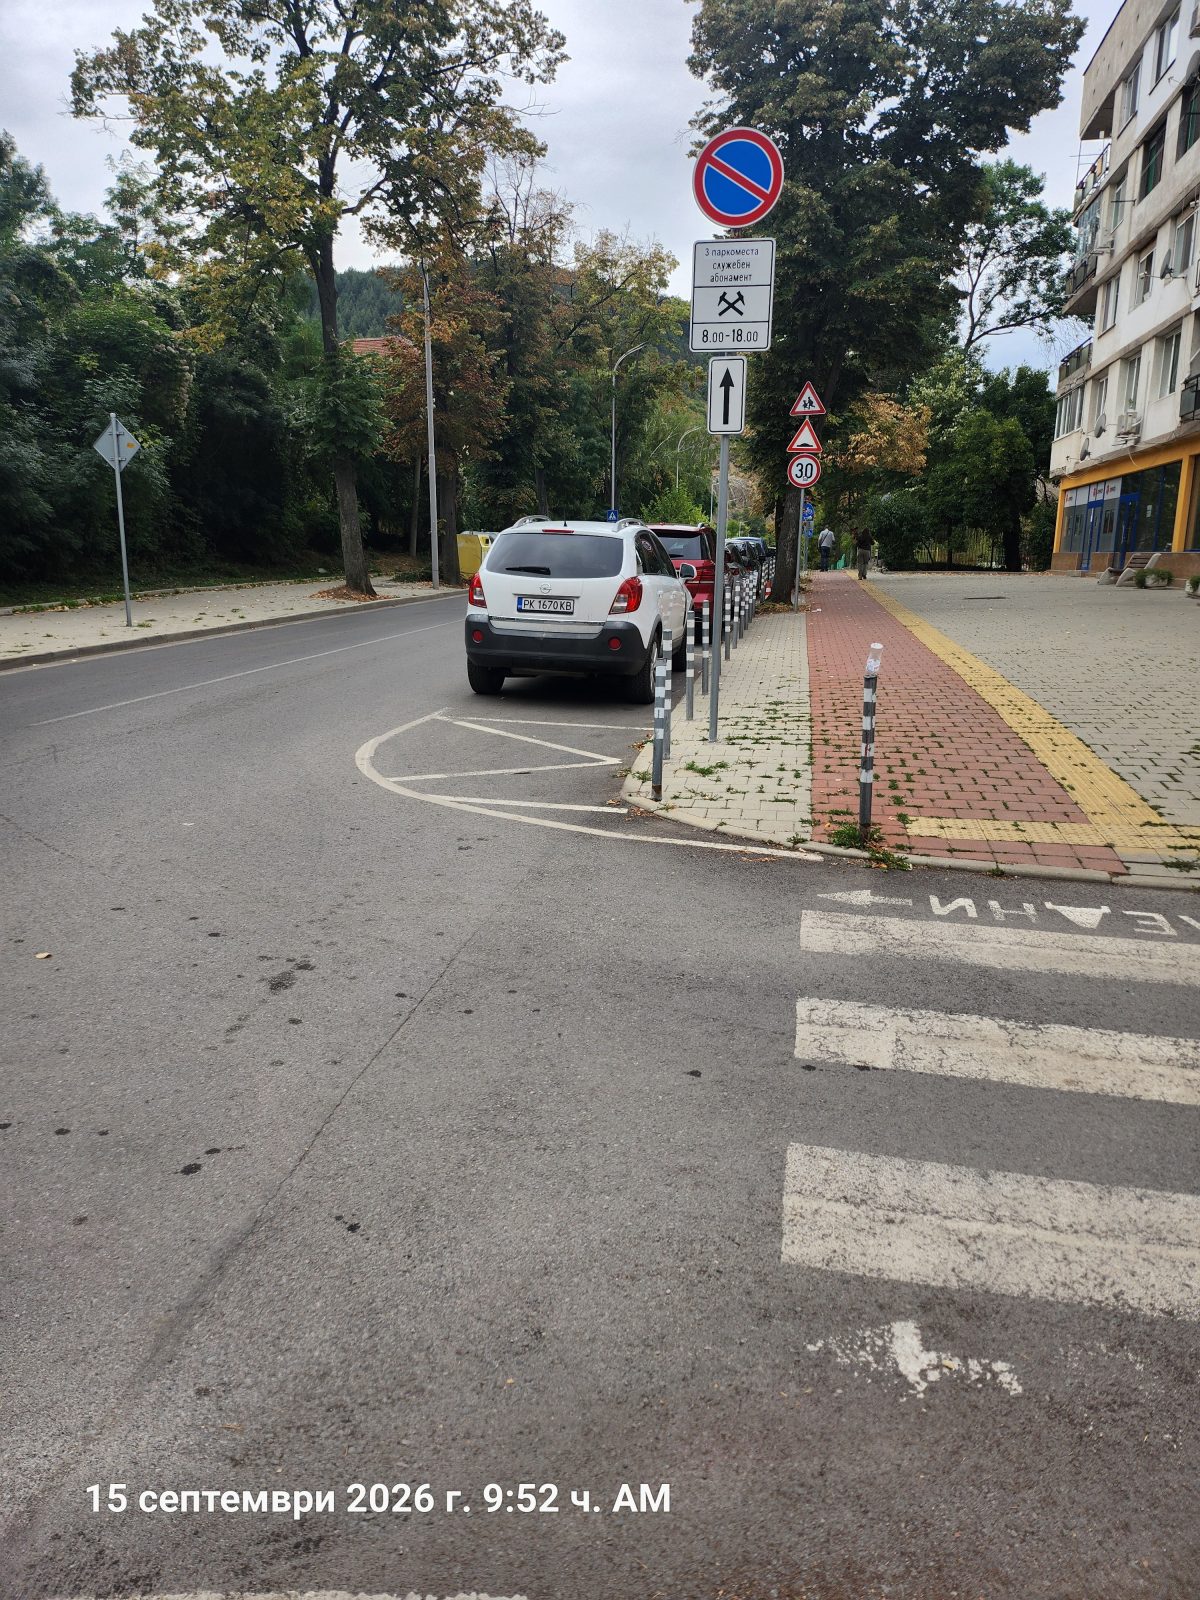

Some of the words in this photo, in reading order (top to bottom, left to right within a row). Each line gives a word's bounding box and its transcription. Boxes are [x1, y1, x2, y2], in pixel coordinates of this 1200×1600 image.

[704, 247, 710, 257] 3
[711, 247, 759, 259] паркоместа
[712, 259, 751, 272] служебен
[710, 273, 752, 283] абонамент
[795, 462, 813, 479] 30
[523, 599, 535, 609] PK
